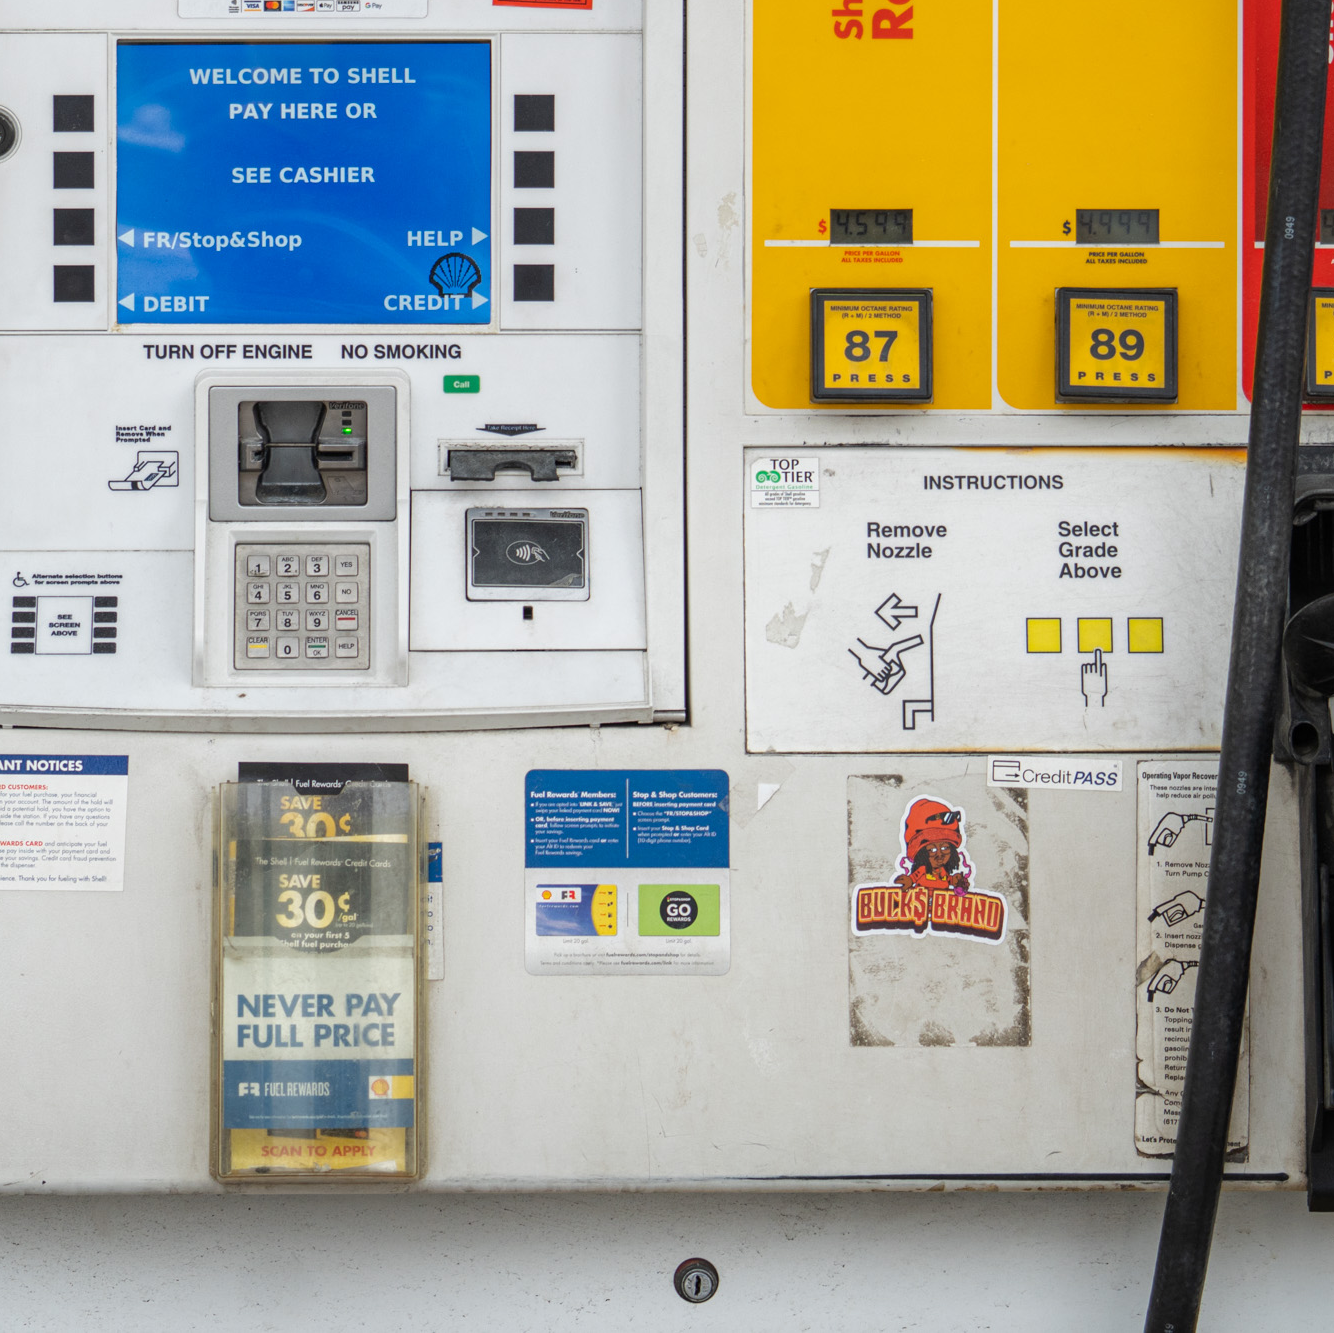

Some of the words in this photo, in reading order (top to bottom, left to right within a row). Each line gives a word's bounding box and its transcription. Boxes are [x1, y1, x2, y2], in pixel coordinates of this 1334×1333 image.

[189, 68, 302, 85] WELCOME
[309, 68, 339, 85] TO
[347, 68, 416, 85] SHELL
[229, 103, 273, 120] PAY
[280, 103, 338, 120] HERE
[346, 103, 377, 120] OR
[231, 167, 272, 184] SEE
[279, 167, 375, 184] CASHIER
[1284, 216, 1295, 239] 0949
[144, 231, 302, 251] FR/Stop&Shop
[407, 230, 464, 247] HELP
[144, 296, 209, 312] DEBIT
[383, 294, 464, 312] CREDIT
[143, 344, 196, 360] TURN
[200, 344, 237, 360] OFF
[242, 344, 313, 360] ENGINE
[341, 344, 369, 360] NO
[373, 344, 462, 360] SMOKING
[844, 330, 898, 362] 87
[1090, 328, 1145, 361] 89
[453, 380, 470, 389] Call
[833, 374, 911, 383] PRESS
[1078, 371, 1156, 382] PRESS
[770, 459, 799, 470] TOP
[782, 471, 813, 482] TIER
[923, 475, 1064, 491] INSTRUCTIONS
[866, 522, 947, 538] Remove
[1058, 521, 1119, 537] Select
[866, 543, 932, 559] Nozzle
[1058, 542, 1118, 559] Grade
[1059, 563, 1122, 580] Above
[26, 760, 83, 772] NOTICES
[1142, 772, 1171, 781] Operating
[1173, 772, 1191, 781] Vapor
[1236, 771, 1247, 794] 0949
[281, 797, 321, 810] SAVE
[279, 874, 320, 888] SAVE
[667, 903, 691, 917] GO
[859, 886, 928, 925] BUCK$
[932, 890, 1002, 931] BRAND
[237, 994, 336, 1018] NEVER
[346, 993, 401, 1016] PAY
[237, 1024, 303, 1048] FULL
[314, 1023, 395, 1047] PRICE
[264, 1082, 286, 1097] FUEL
[287, 1082, 330, 1097] REWARDS
[261, 1146, 302, 1157] SCAN
[307, 1146, 327, 1157] TO
[332, 1145, 376, 1157] APPLY
